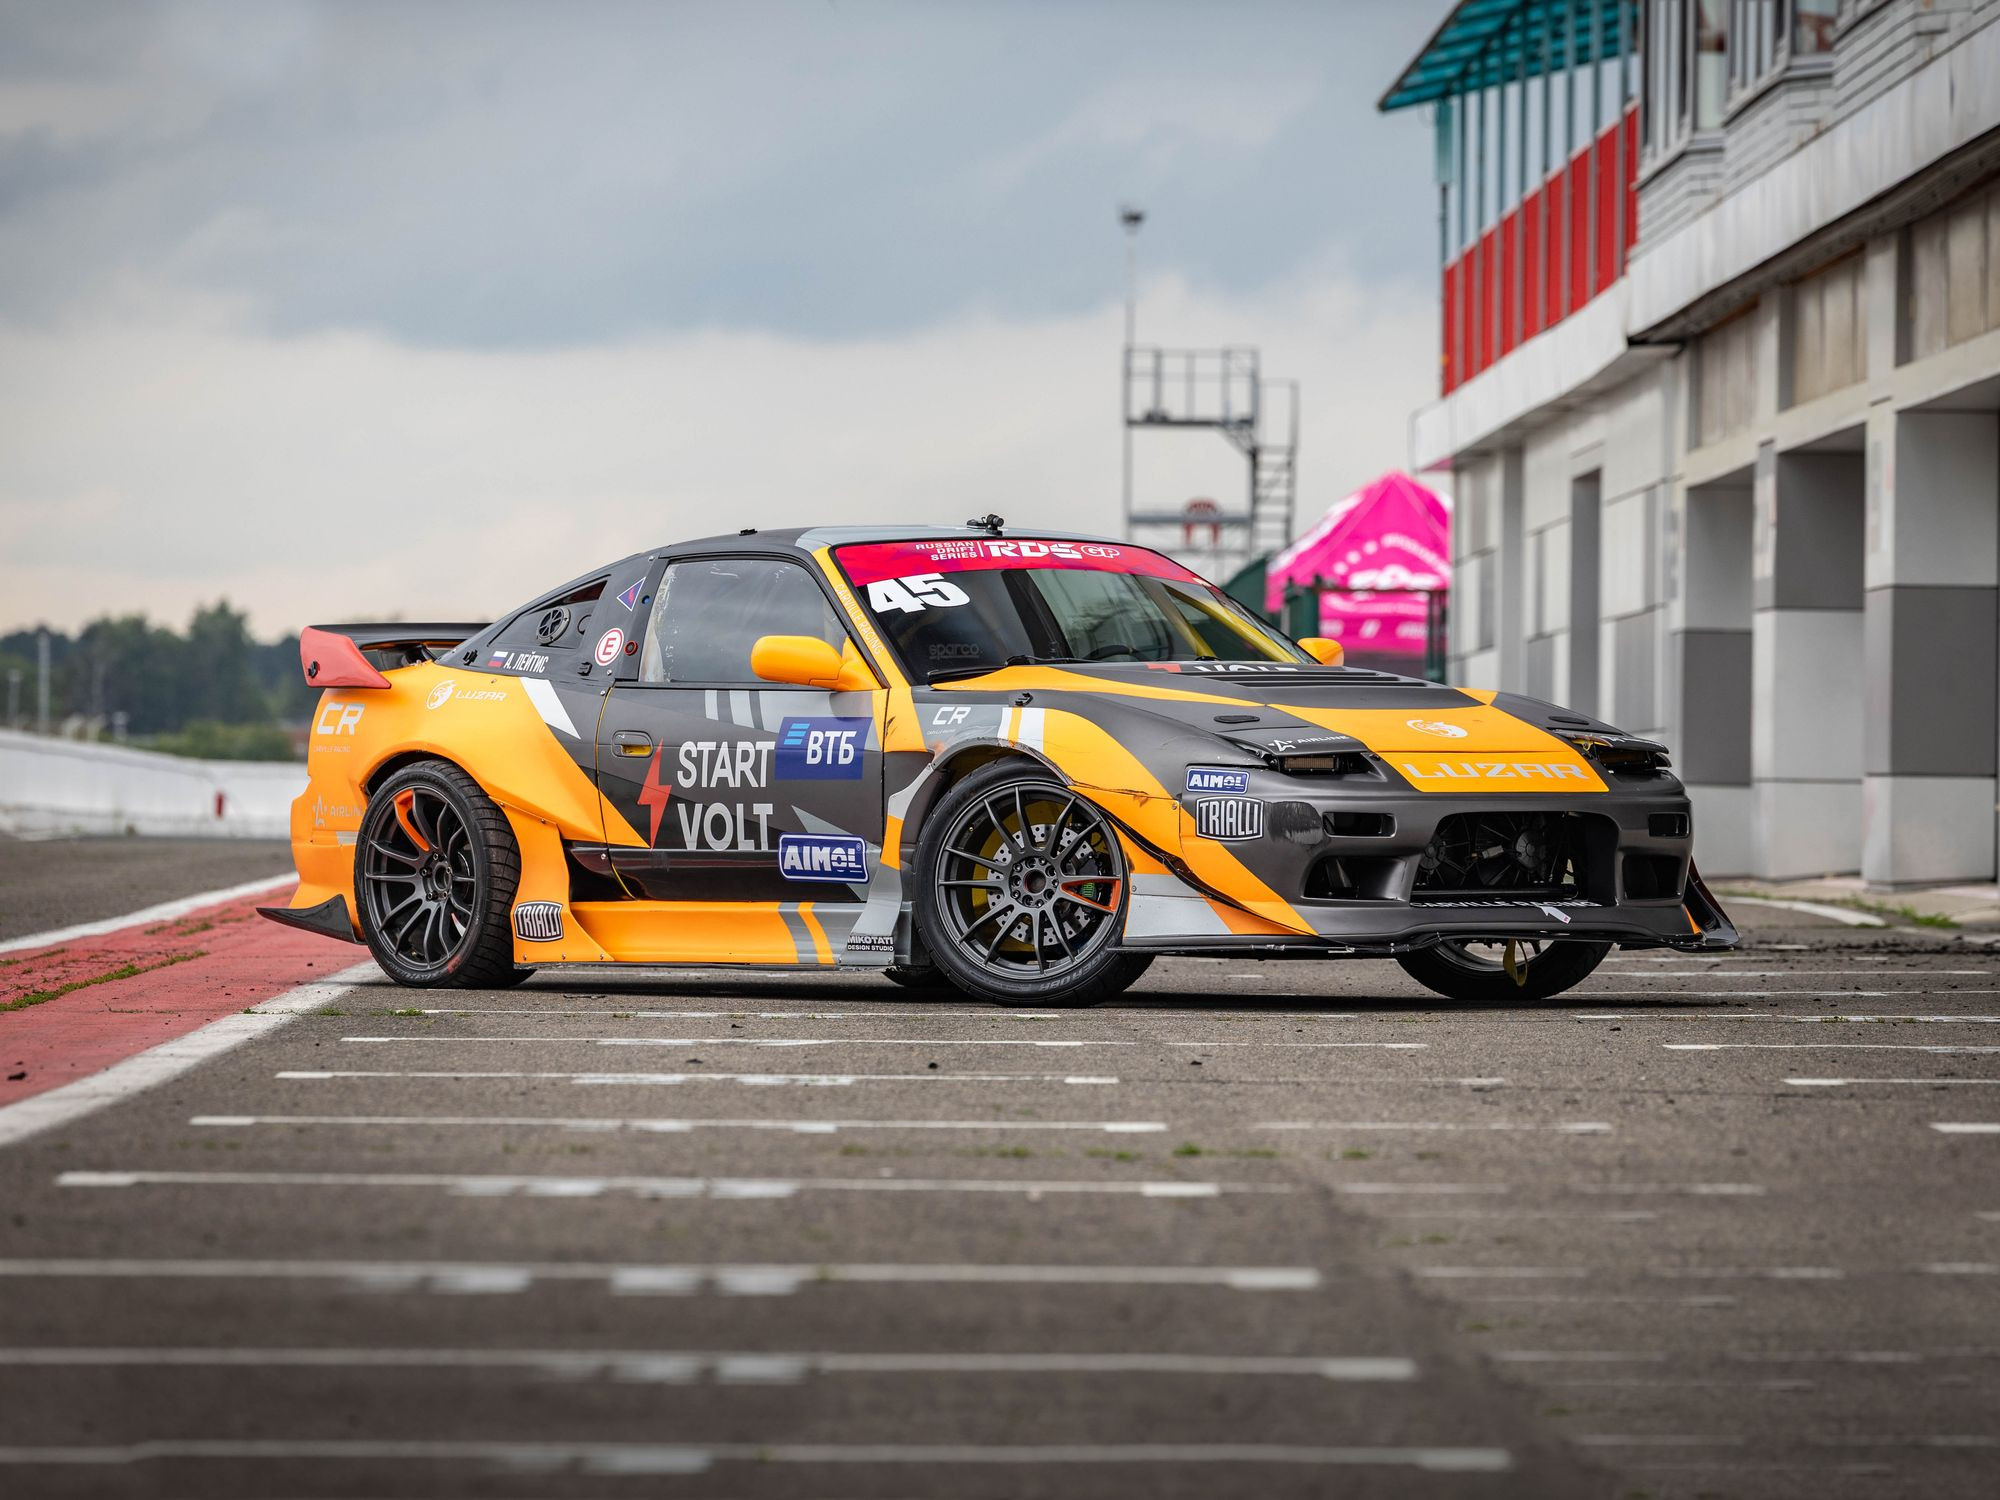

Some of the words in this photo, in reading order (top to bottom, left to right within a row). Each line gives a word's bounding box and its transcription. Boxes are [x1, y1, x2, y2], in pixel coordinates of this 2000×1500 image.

[916, 541, 974, 550] RUSSIAN
[984, 541, 1082, 559] RDS
[1081, 545, 1120, 558] GP
[931, 551, 977, 561] SERIES
[867, 573, 970, 613] 45
[835, 583, 865, 620] CARVILLE
[858, 620, 884, 655] RACING
[602, 637, 616, 655] E
[929, 643, 979, 660] sparco
[513, 650, 549, 673] ЛЕЙТИС
[455, 690, 507, 702] LUZAR
[316, 702, 365, 735] CR
[932, 707, 971, 725] CR
[806, 730, 857, 765] ВТБ
[677, 741, 775, 788] START
[1400, 763, 1589, 779] LUZAR
[1189, 774, 1244, 789] AIMOL
[677, 802, 773, 851] VOLT
[1200, 800, 1258, 836] TRIALLI
[784, 845, 863, 873] AIMOL
[518, 904, 560, 937] TRIALLI
[847, 936, 894, 944] MIKOTATI
